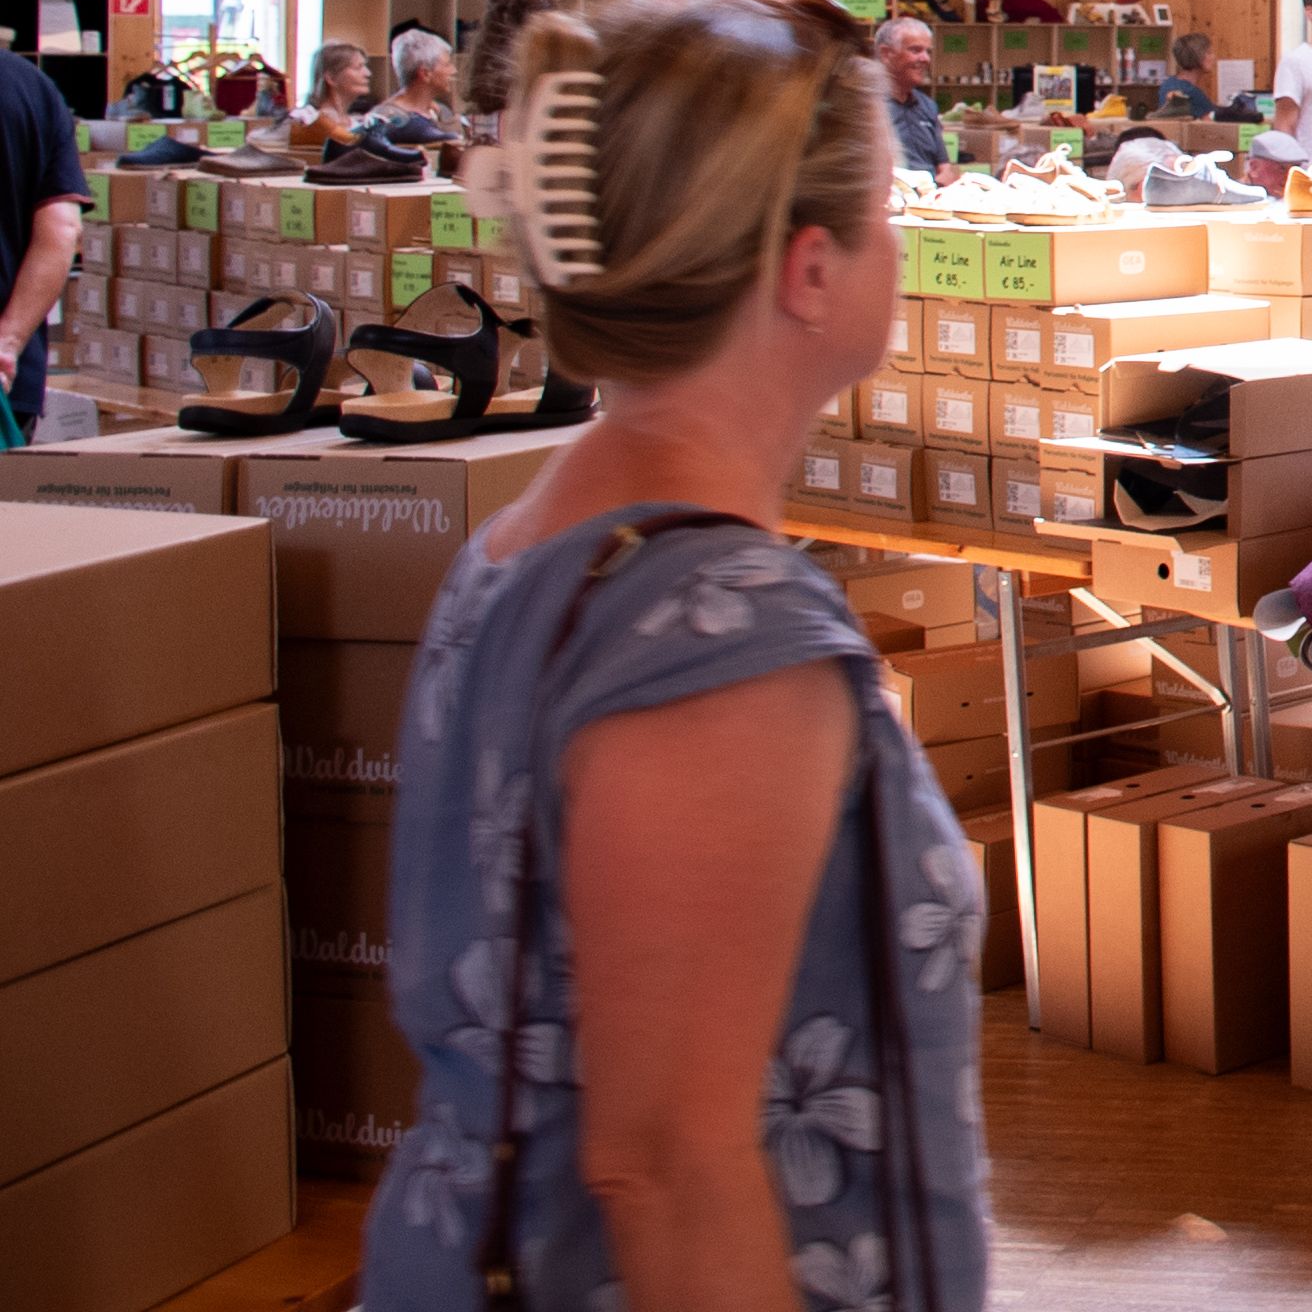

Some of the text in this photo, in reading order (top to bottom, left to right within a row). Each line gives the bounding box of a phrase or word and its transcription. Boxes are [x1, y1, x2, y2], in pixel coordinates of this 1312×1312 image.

[934, 252, 969, 267] Air Line
[999, 255, 1037, 269] Air Line
[935, 272, 943, 285] €
[1002, 276, 1009, 289] €
[282, 481, 417, 495] Fortschritt für Fußgänger
[256, 495, 451, 534] Waldviertler
[283, 745, 404, 783] Waldvie
[291, 927, 394, 965] Waldvi
[295, 1108, 408, 1147] Waldvi
